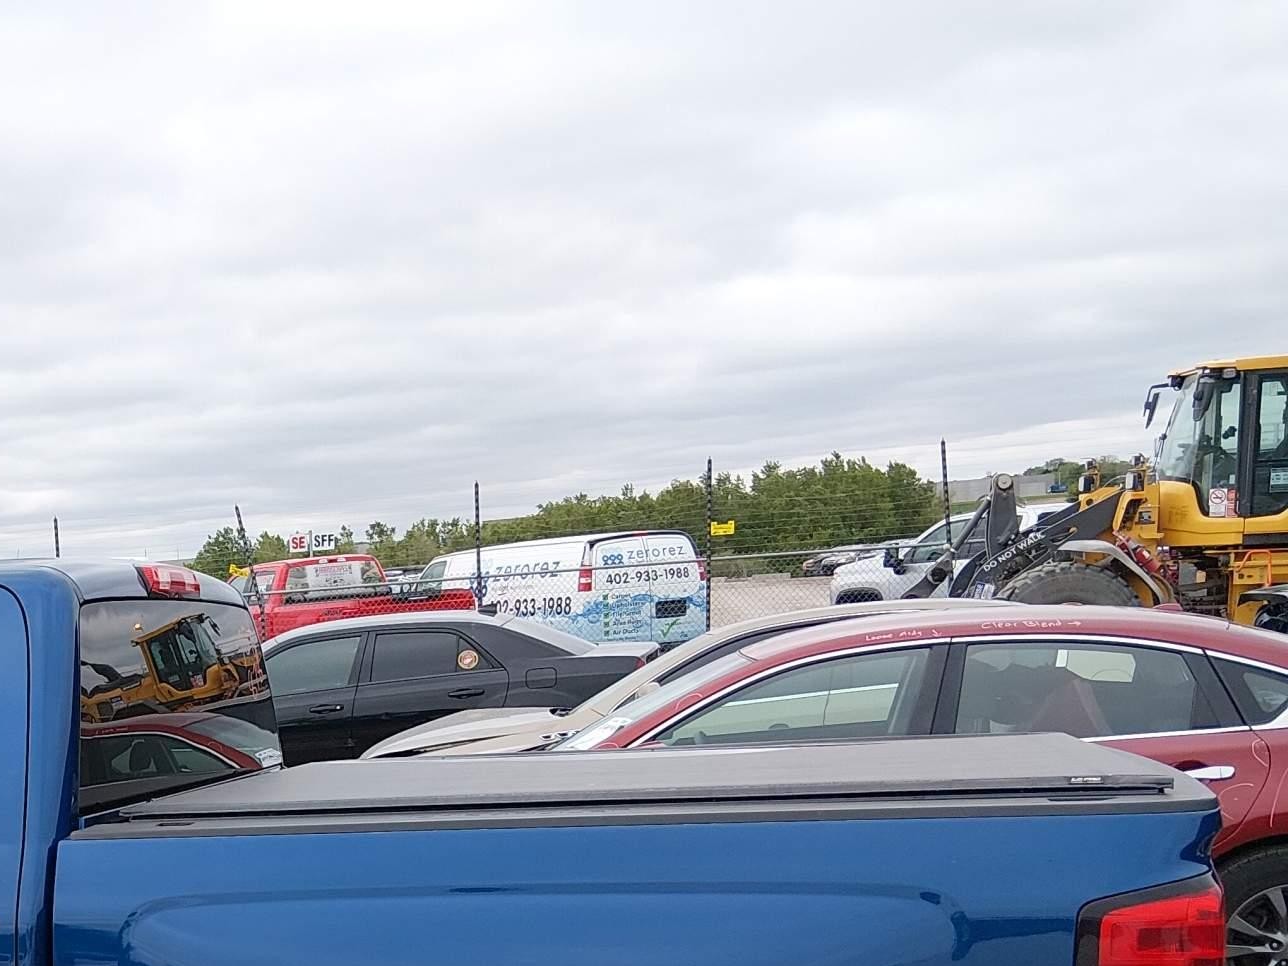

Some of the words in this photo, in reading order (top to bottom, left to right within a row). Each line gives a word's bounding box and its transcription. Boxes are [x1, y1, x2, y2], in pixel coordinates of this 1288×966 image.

[627, 546, 685, 560] zerorez
[983, 560, 998, 572] DO
[997, 546, 1017, 563] NOT
[1016, 531, 1046, 550] WALK
[492, 561, 561, 582] zerorez
[606, 566, 690, 585] 402-933-1988
